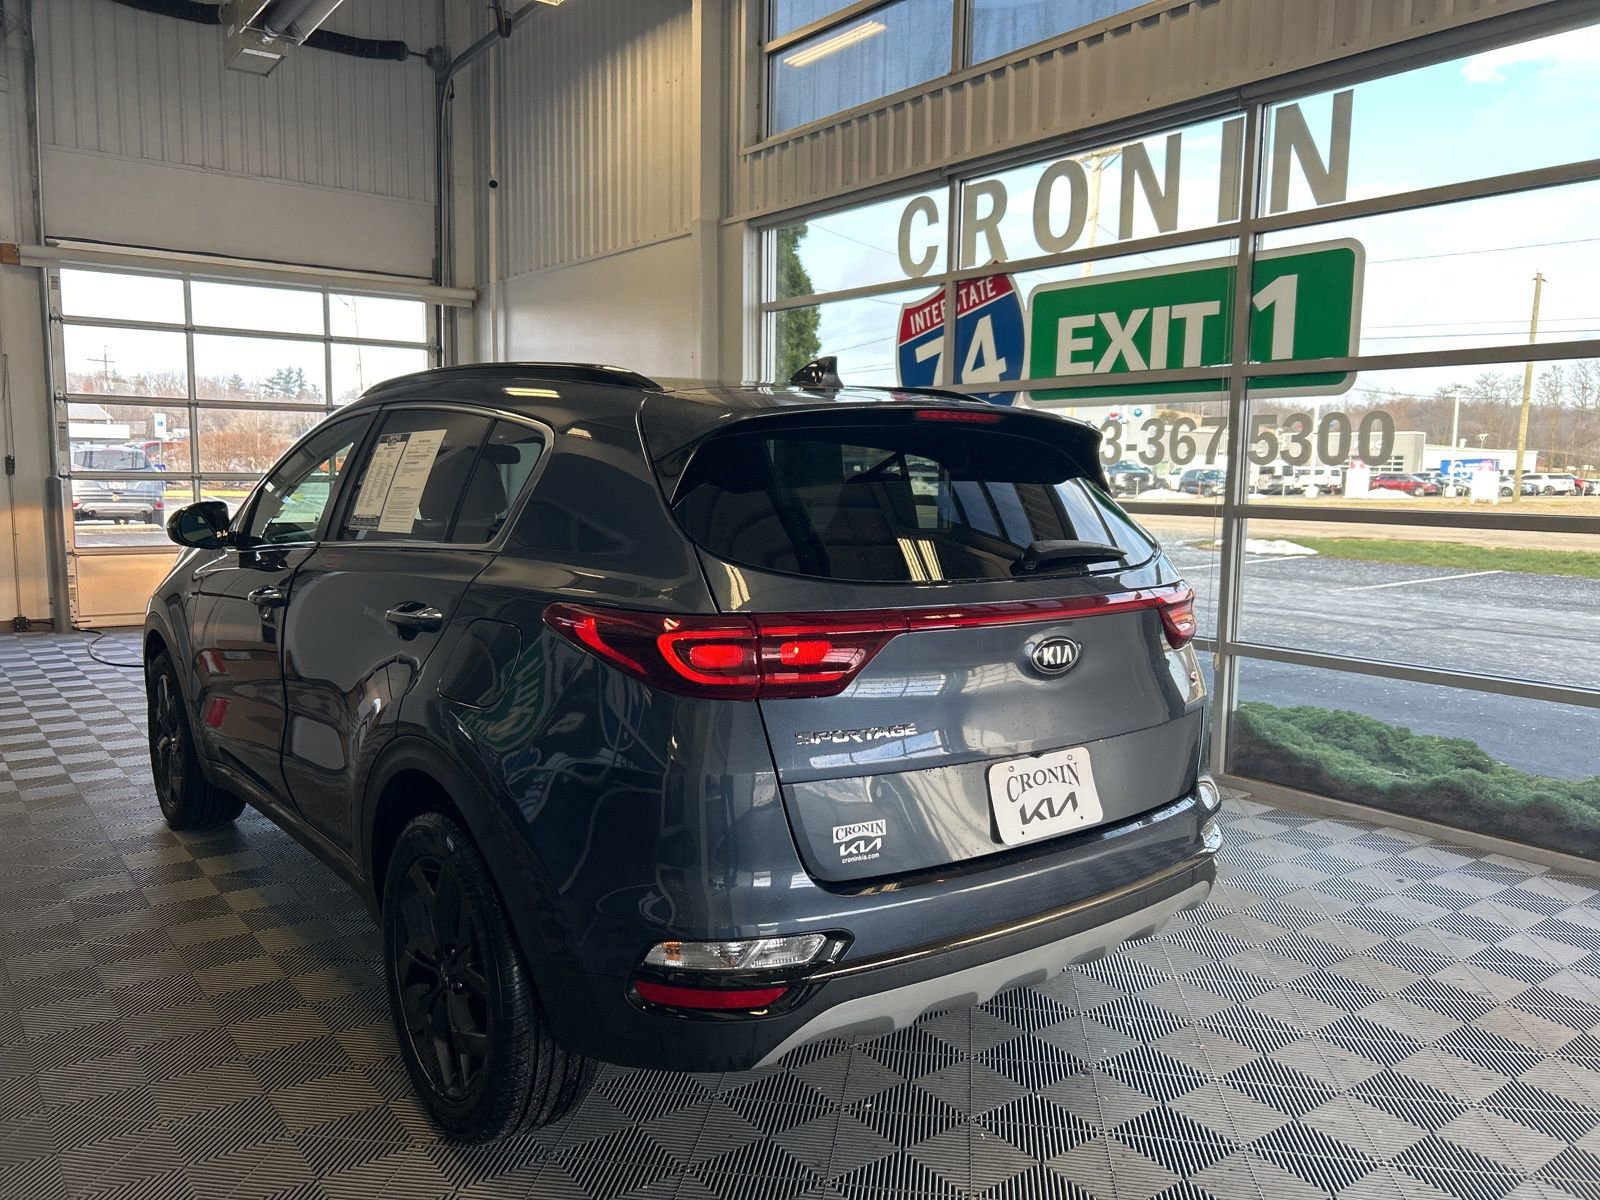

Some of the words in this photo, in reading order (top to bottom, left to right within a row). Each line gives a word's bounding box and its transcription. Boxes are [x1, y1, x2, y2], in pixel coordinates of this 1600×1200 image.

[898, 89, 1354, 279] CRONIN
[910, 276, 997, 335] INTETATE
[1055, 300, 1221, 376] EXIT
[1252, 274, 1298, 361] 1
[915, 314, 1008, 398] 74
[1042, 645, 1074, 666] KIA
[795, 722, 919, 746] SPORTAGE
[1006, 761, 1081, 803] CRONIN
[835, 821, 885, 841] CRONIN
[841, 852, 880, 864] croninkia.com
